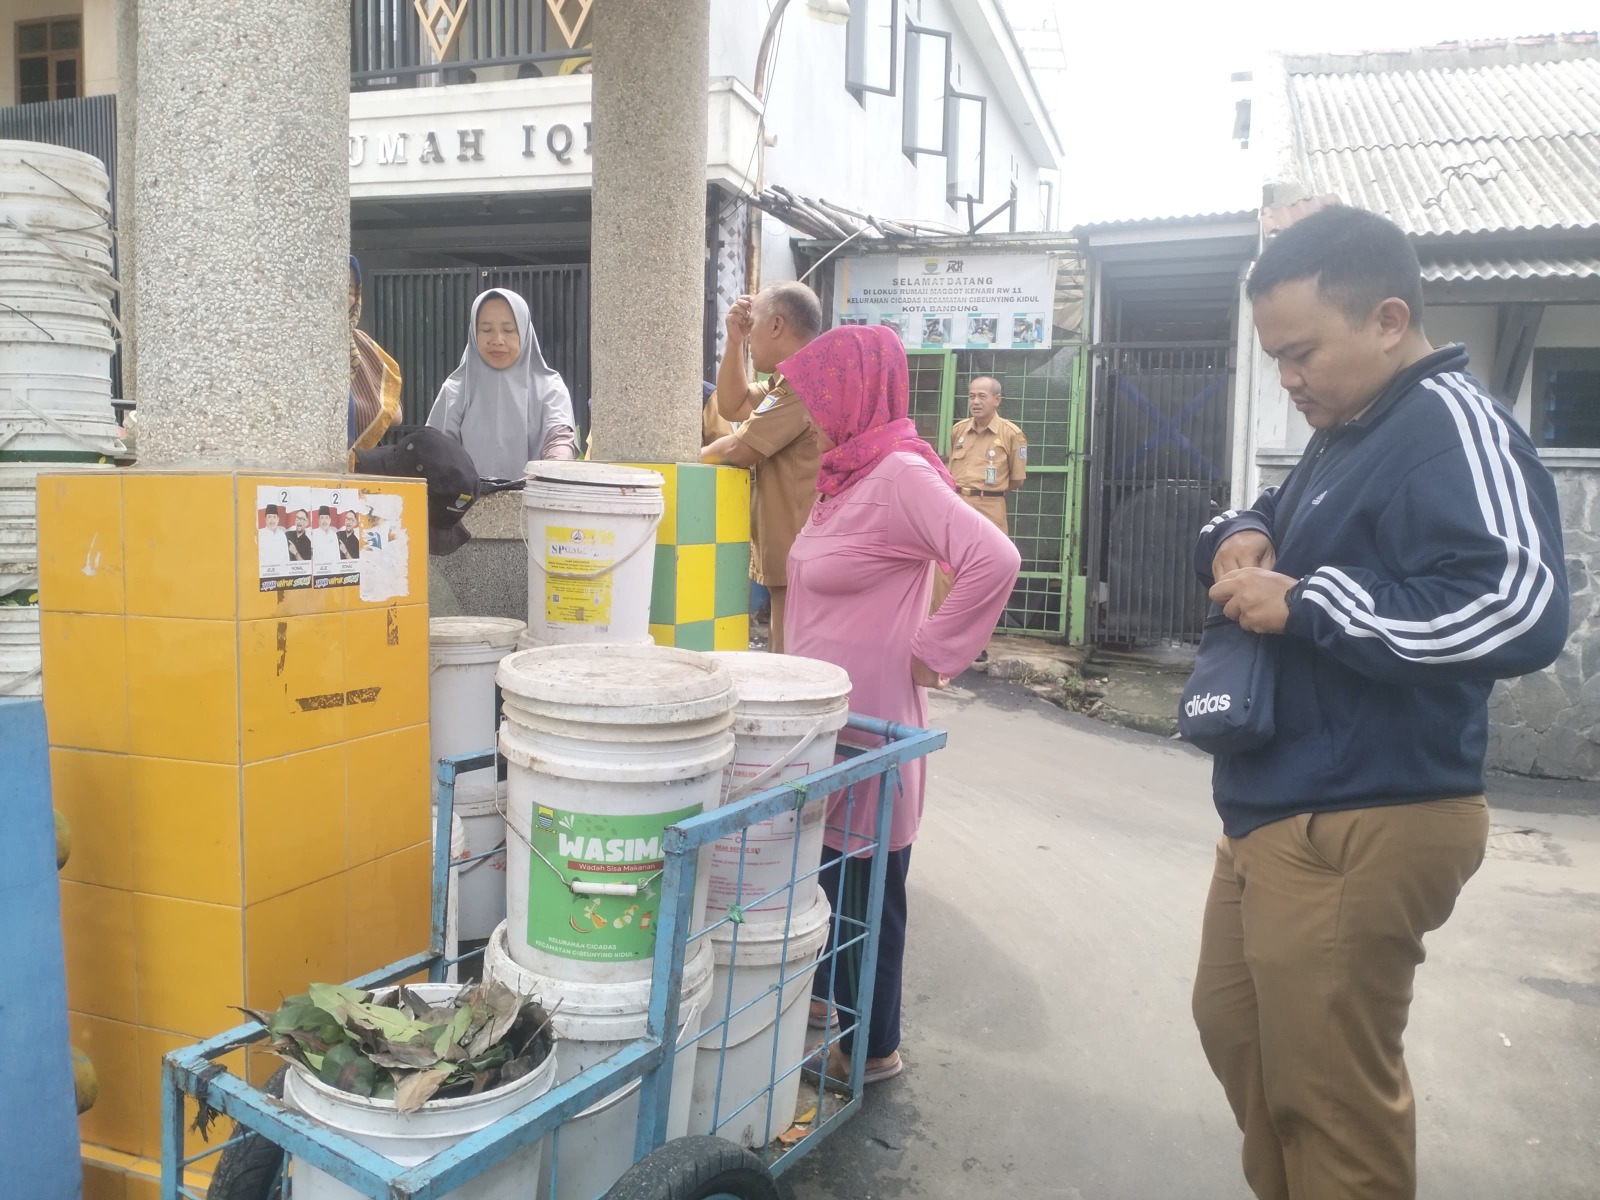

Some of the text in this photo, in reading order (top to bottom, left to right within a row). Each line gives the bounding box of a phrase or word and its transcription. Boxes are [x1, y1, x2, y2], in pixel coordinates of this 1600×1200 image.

[892, 277, 993, 286] SELAMAT DATANG
[873, 288, 898, 296] LOKUS
[923, 296, 967, 304] KECAMATAN
[281, 491, 288, 503] 2
[332, 493, 339, 505] 2
[1184, 692, 1231, 718] didas
[579, 863, 604, 872] Wadah
[623, 863, 656, 872] Makanan
[535, 939, 571, 955] KECAMATAN
[572, 949, 613, 958] CIBEUNYING
[548, 936, 586, 949] KELURAHAN
